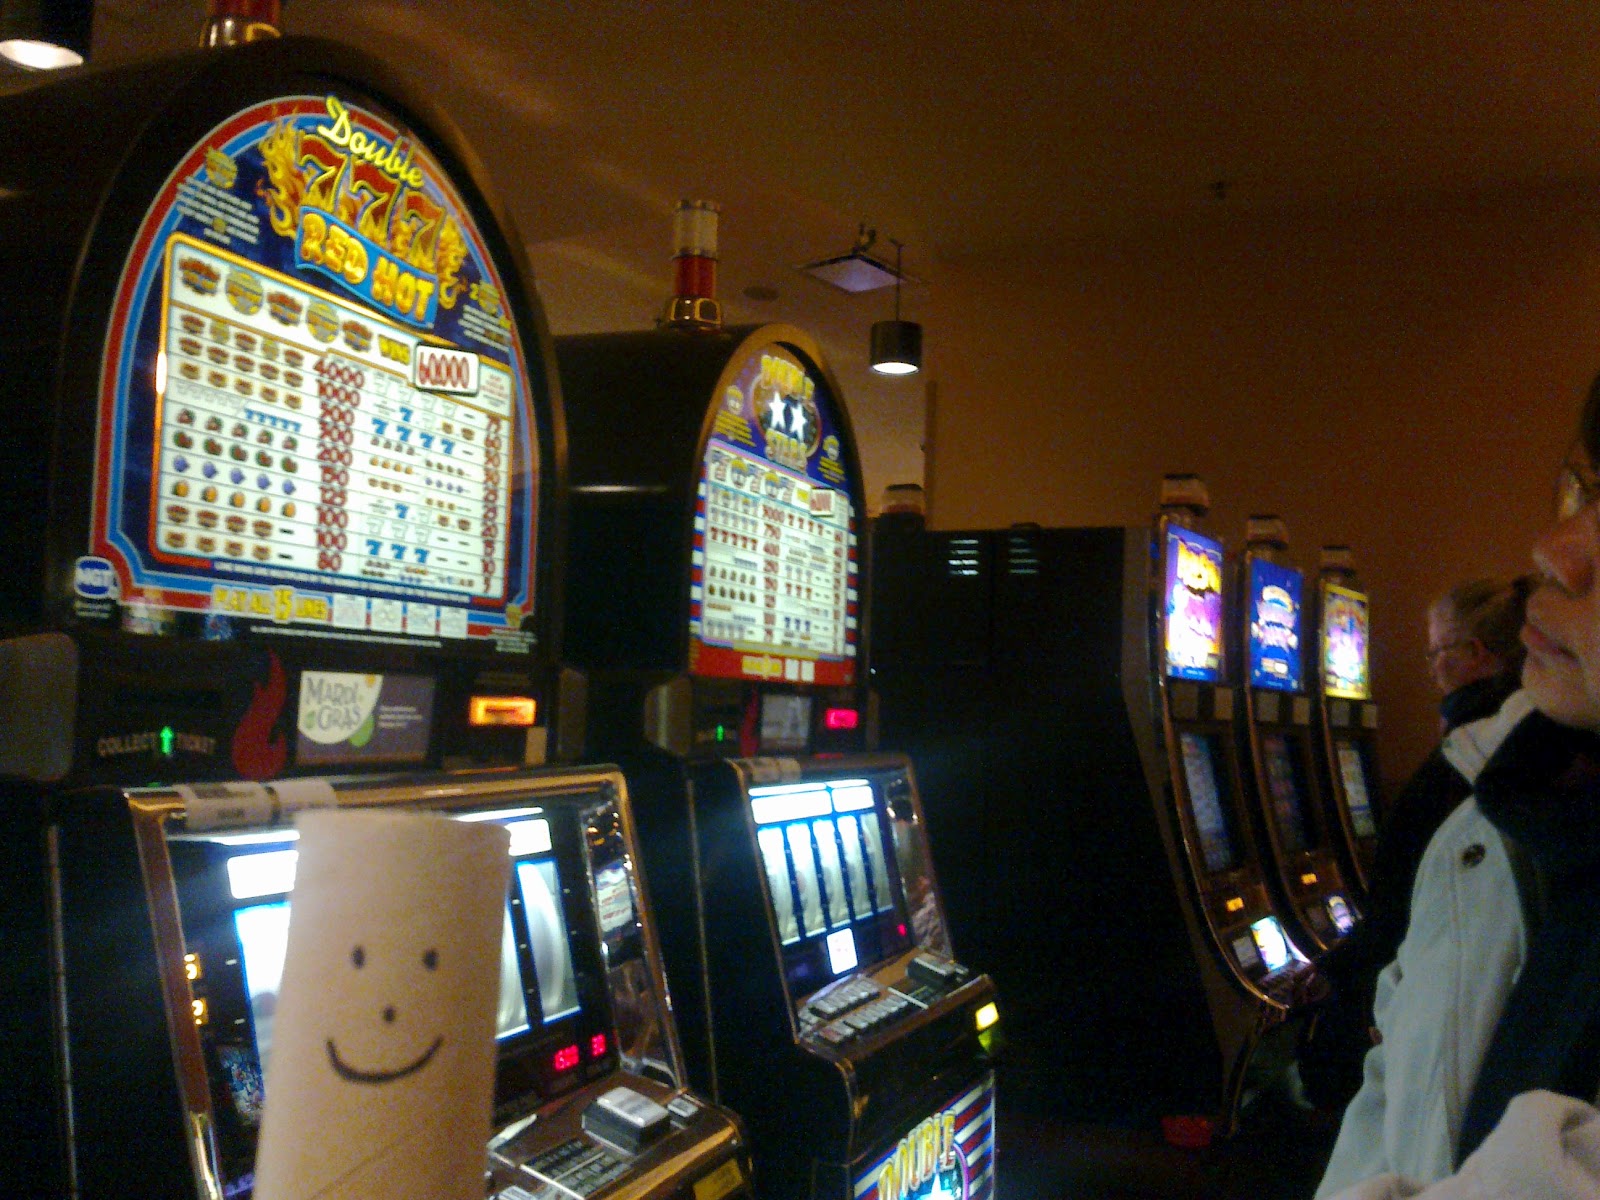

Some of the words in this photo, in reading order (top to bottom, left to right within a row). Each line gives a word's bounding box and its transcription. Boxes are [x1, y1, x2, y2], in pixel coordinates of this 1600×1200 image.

[317, 96, 425, 188] Double
[300, 211, 369, 285] RED
[371, 256, 437, 322] HOT
[306, 676, 359, 705] MARDI
[318, 704, 362, 732] GRAS
[878, 1109, 955, 1200] DOUBLE
